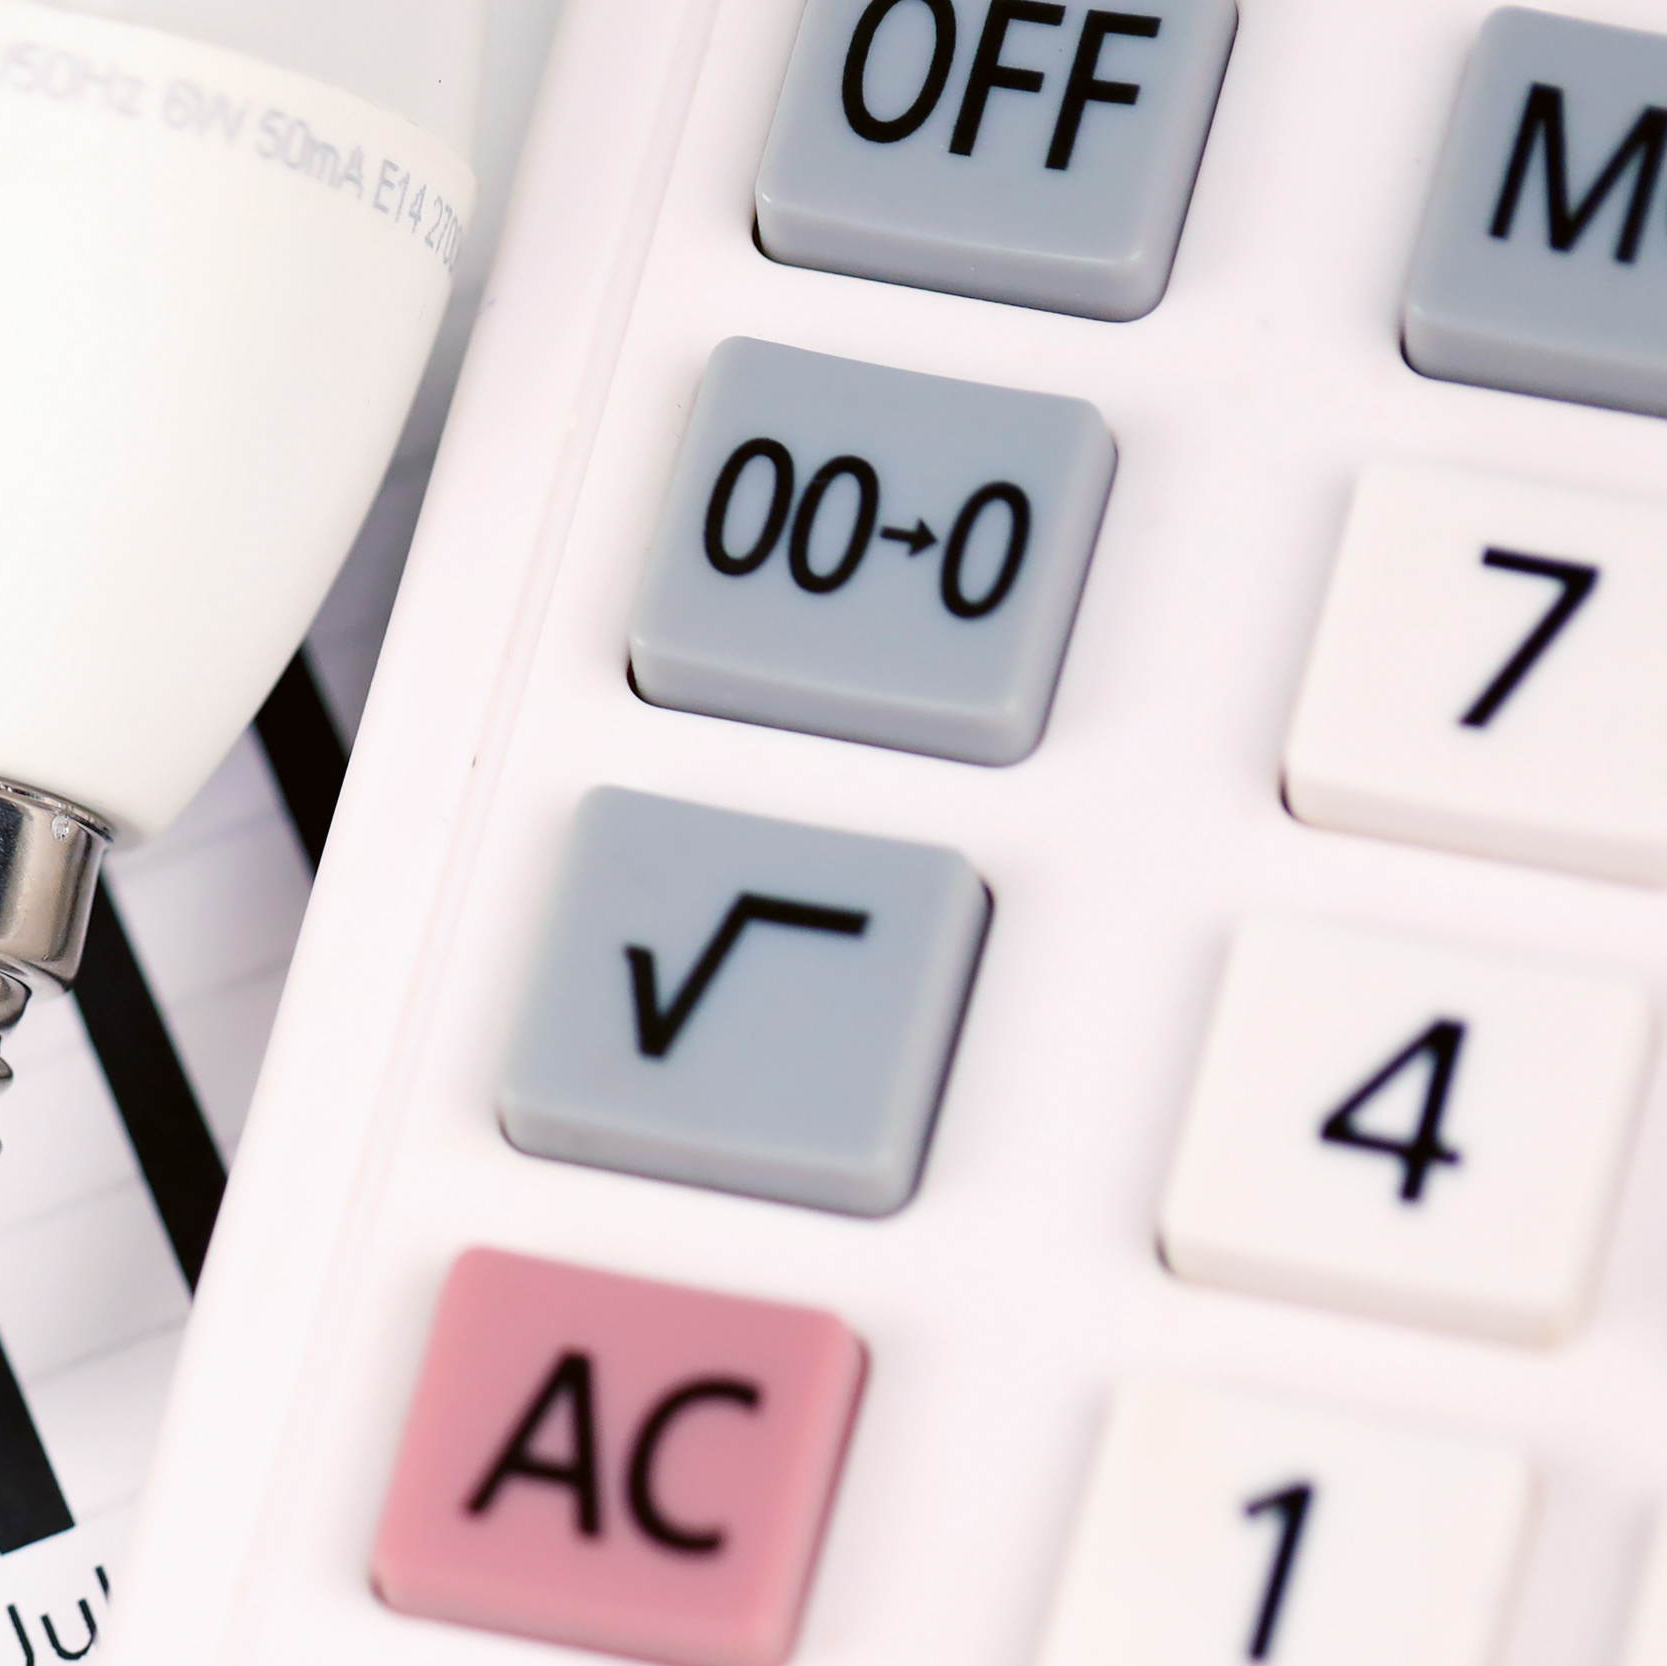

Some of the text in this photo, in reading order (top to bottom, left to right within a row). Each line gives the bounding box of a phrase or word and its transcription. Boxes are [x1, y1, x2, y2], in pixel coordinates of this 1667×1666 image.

[255, 106, 366, 203] 50mA
[372, 156, 427, 235] E14
[840, 0, 1163, 172] OFF
[1459, 546, 1599, 729] 7
[1317, 1018, 1466, 1203] 4
[463, 1348, 763, 1558] AC
[1241, 1480, 1315, 1664] 1
